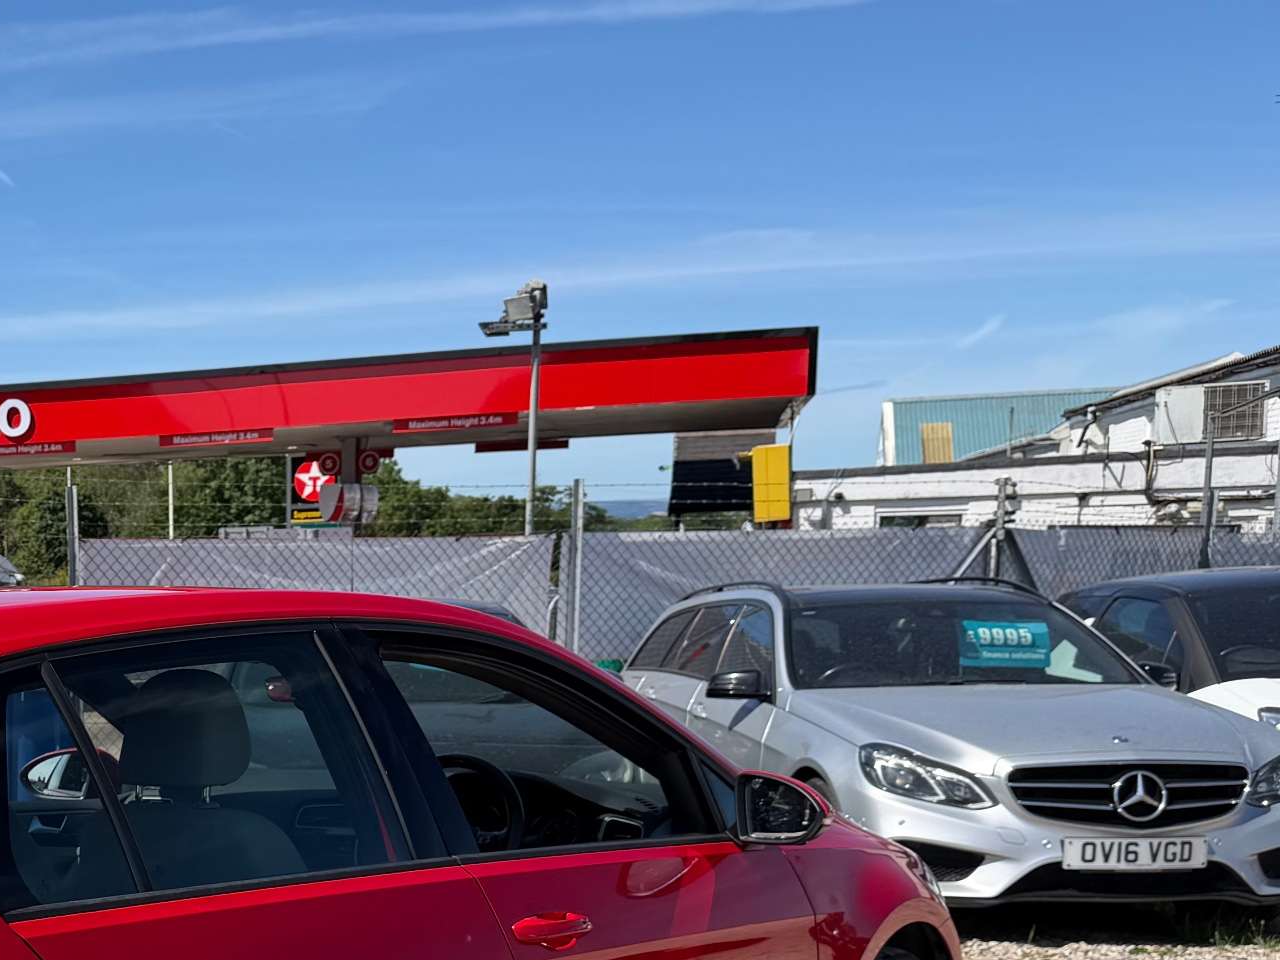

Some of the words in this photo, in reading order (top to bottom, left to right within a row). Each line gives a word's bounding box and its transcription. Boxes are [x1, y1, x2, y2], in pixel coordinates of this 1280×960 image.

[450, 416, 479, 428] Height
[1081, 841, 1138, 864] OV16
[1149, 840, 1192, 863] VGD
